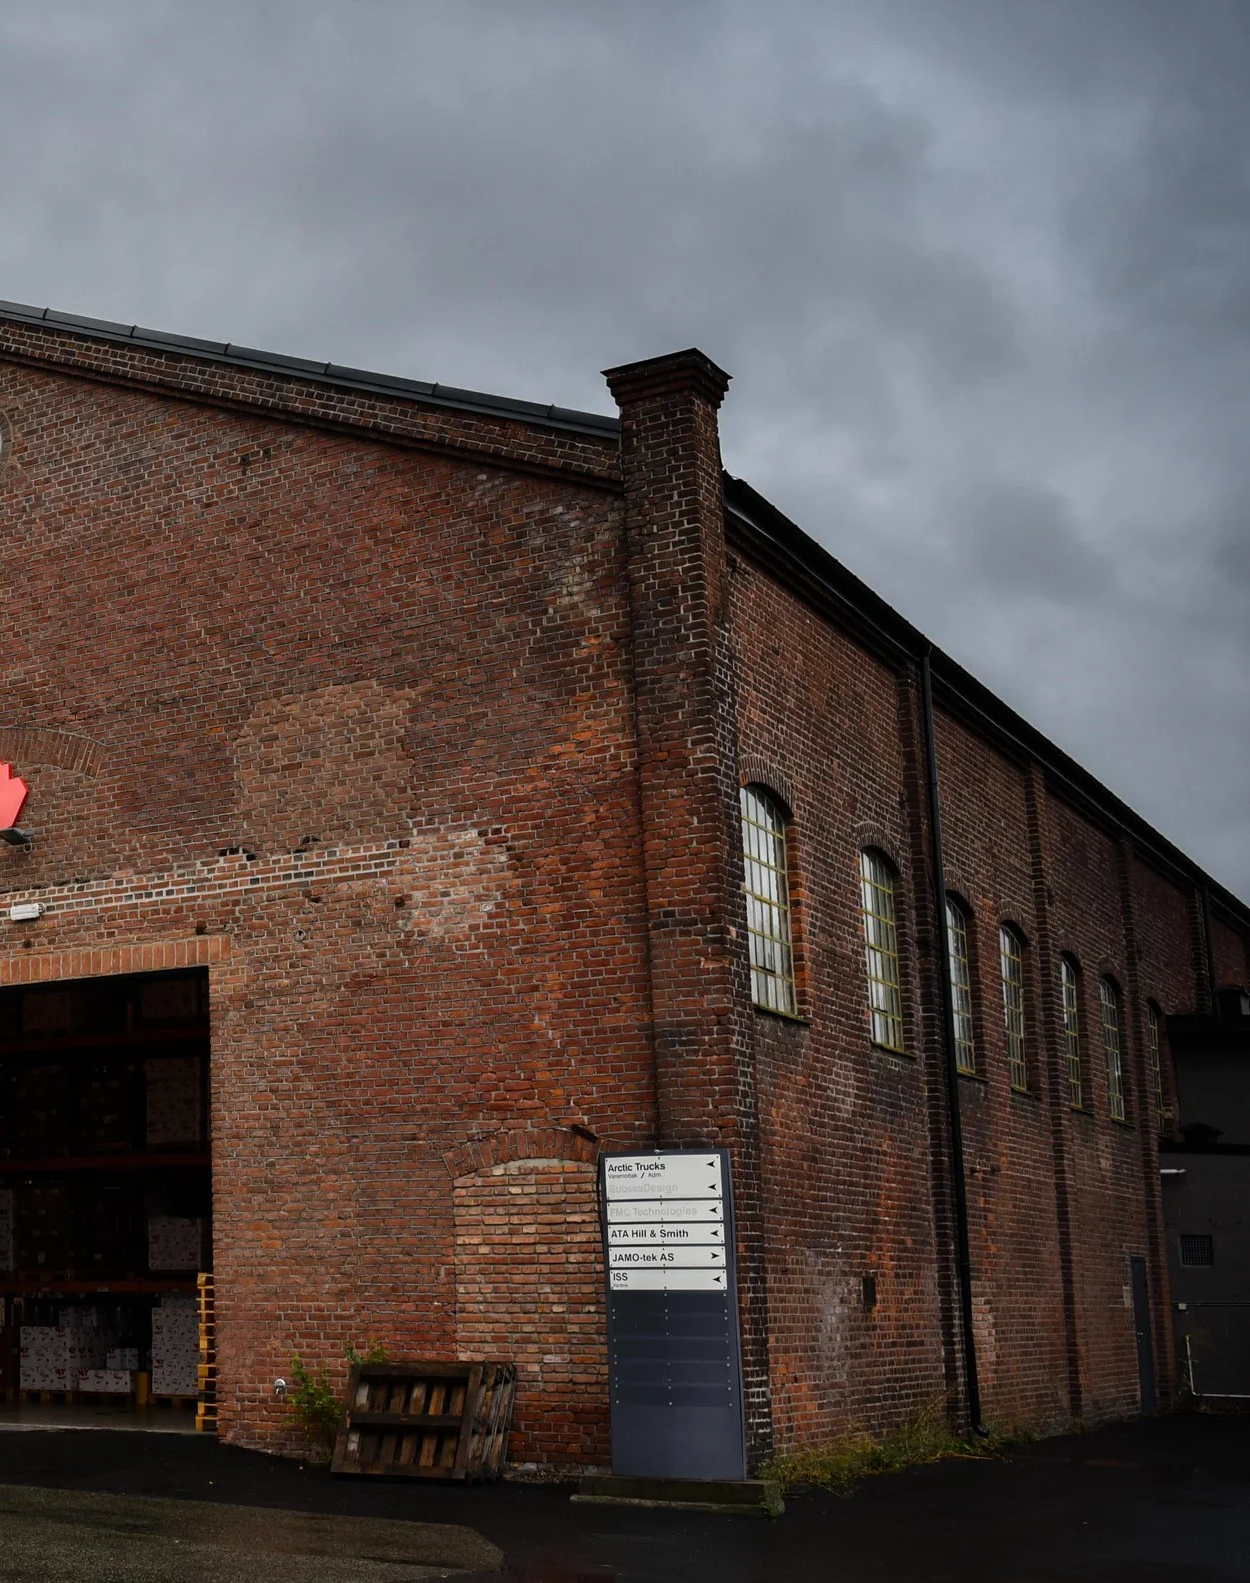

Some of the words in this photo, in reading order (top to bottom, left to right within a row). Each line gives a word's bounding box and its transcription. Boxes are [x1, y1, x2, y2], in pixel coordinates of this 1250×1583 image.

[608, 1163, 632, 1172] Arctic
[635, 1162, 665, 1171] Trucks
[610, 1208, 630, 1217] FMC
[611, 1230, 629, 1238] ATA
[631, 1229, 647, 1238] Hill
[649, 1229, 657, 1238] &
[659, 1229, 689, 1238] Smith
[612, 1253, 657, 1262] JAMO-tek
[659, 1253, 675, 1262] AS
[613, 1272, 628, 1281] ISS
